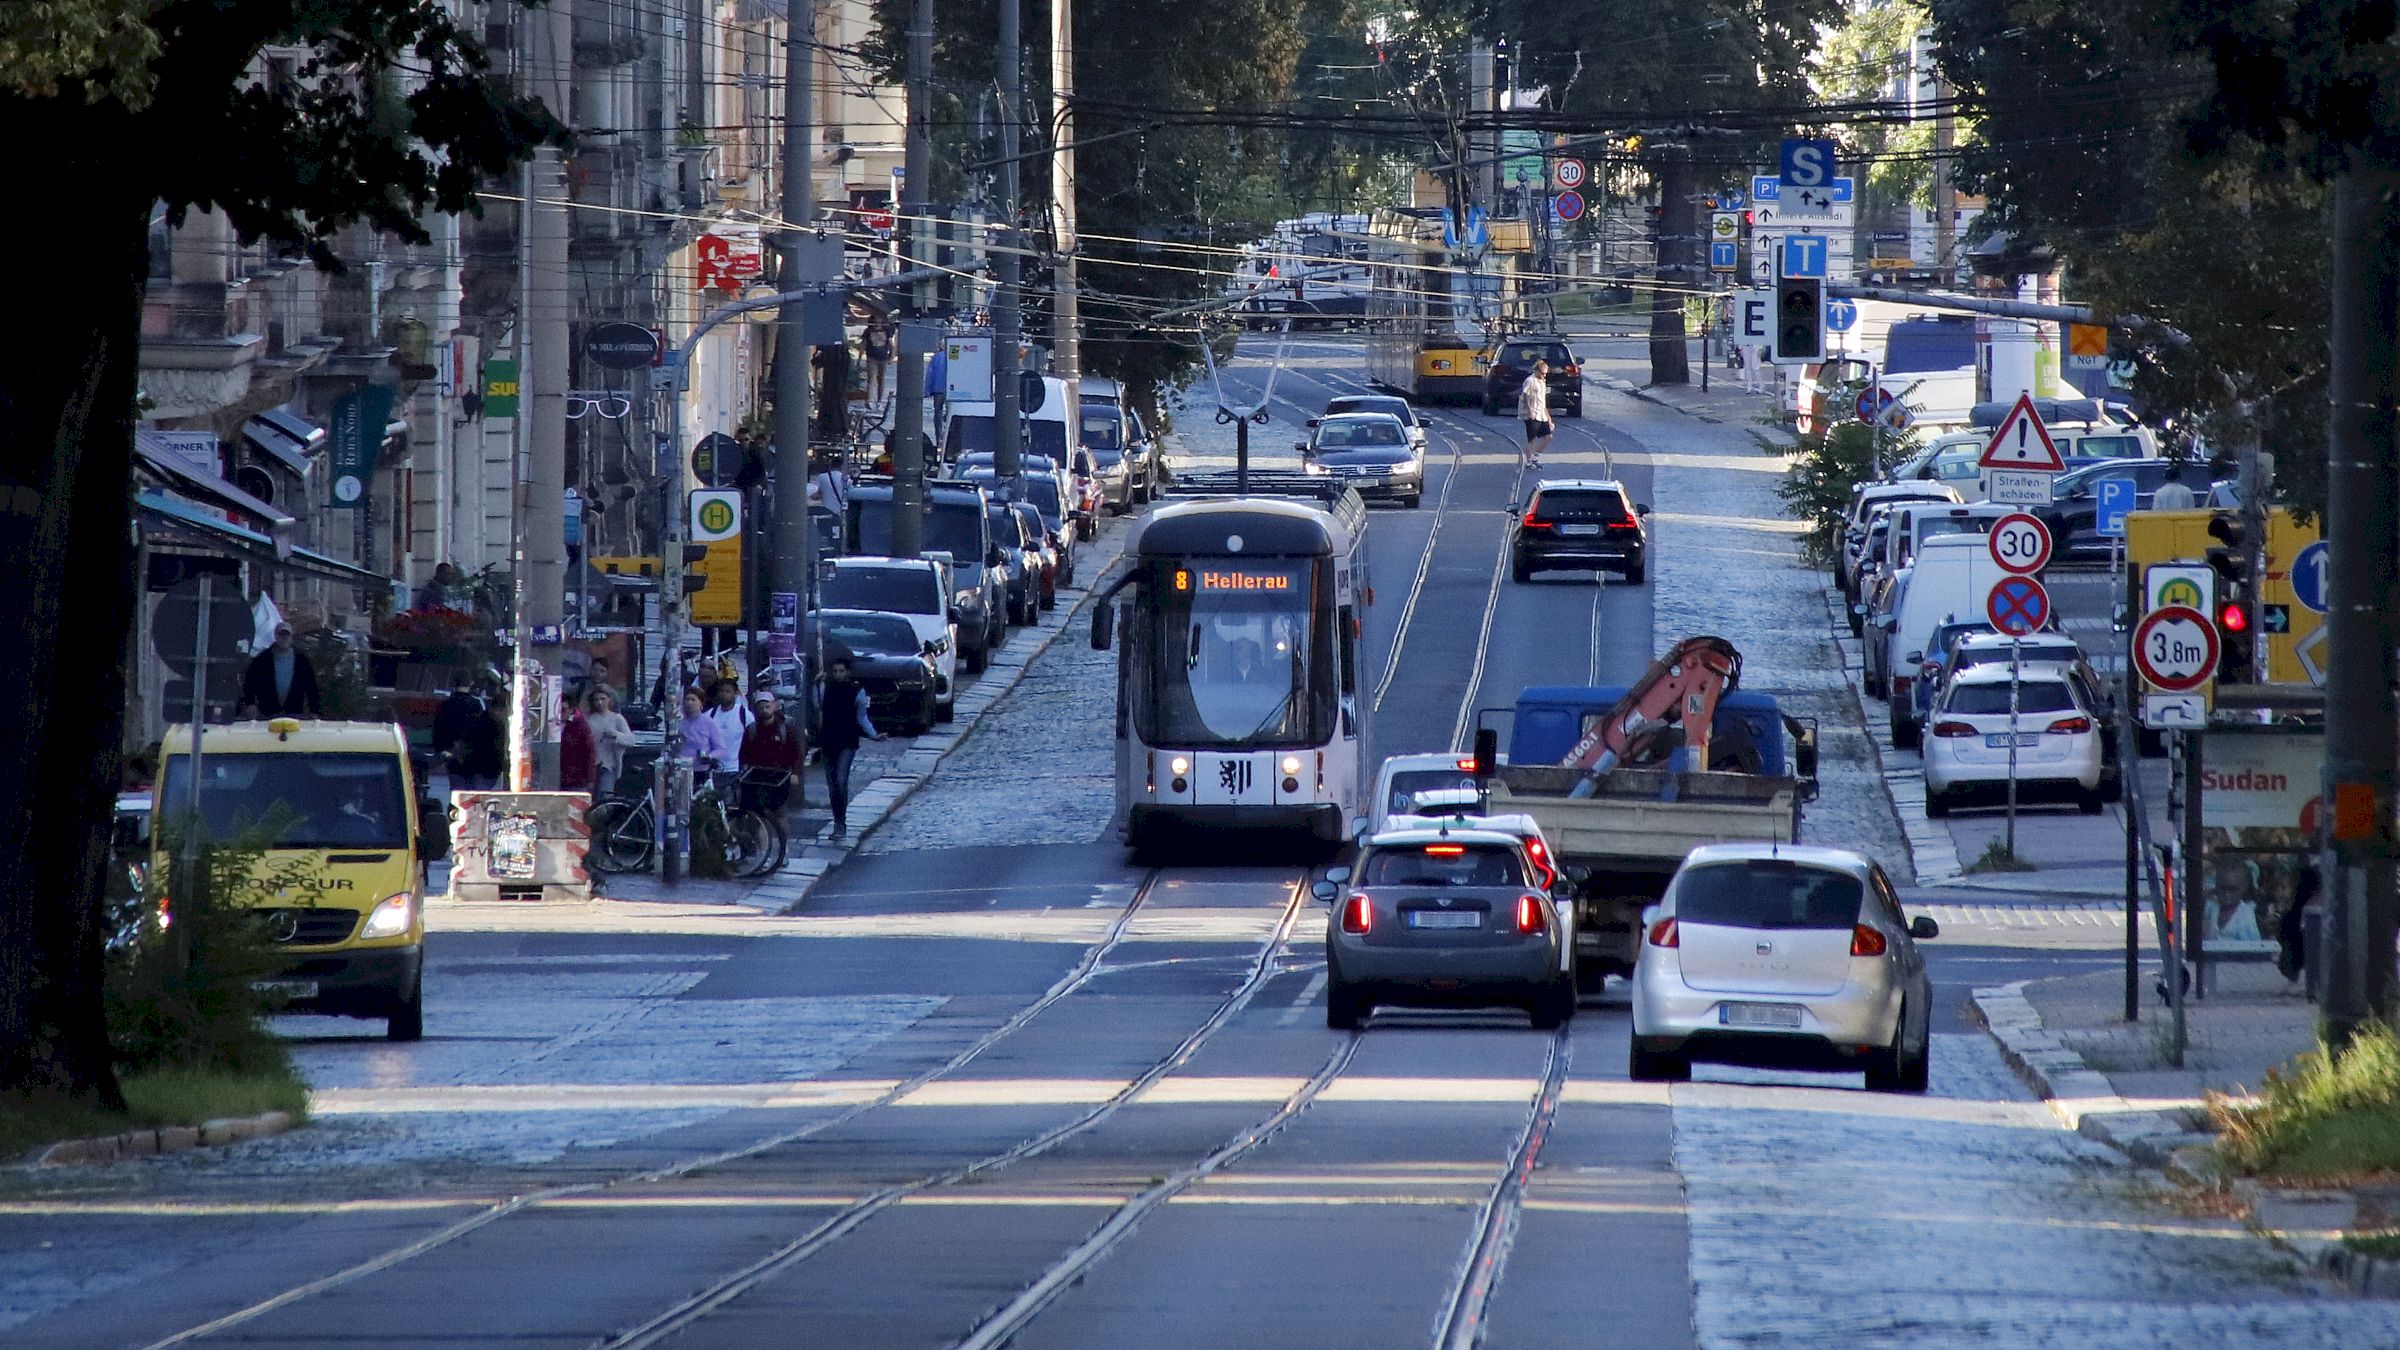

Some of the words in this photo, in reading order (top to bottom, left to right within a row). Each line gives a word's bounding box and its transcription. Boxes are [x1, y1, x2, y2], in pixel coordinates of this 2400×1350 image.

[1562, 166, 1579, 180] 30
[1791, 146, 1824, 186] S
[1761, 184, 1770, 195] P
[1794, 239, 1819, 272] T
[1745, 301, 1765, 336] E
[2104, 484, 2120, 506] P
[709, 507, 725, 527] H
[2001, 530, 2036, 558] 30
[1175, 570, 1189, 591] 8
[1203, 571, 1288, 590] Hellerau
[2202, 768, 2288, 792] Sudan
